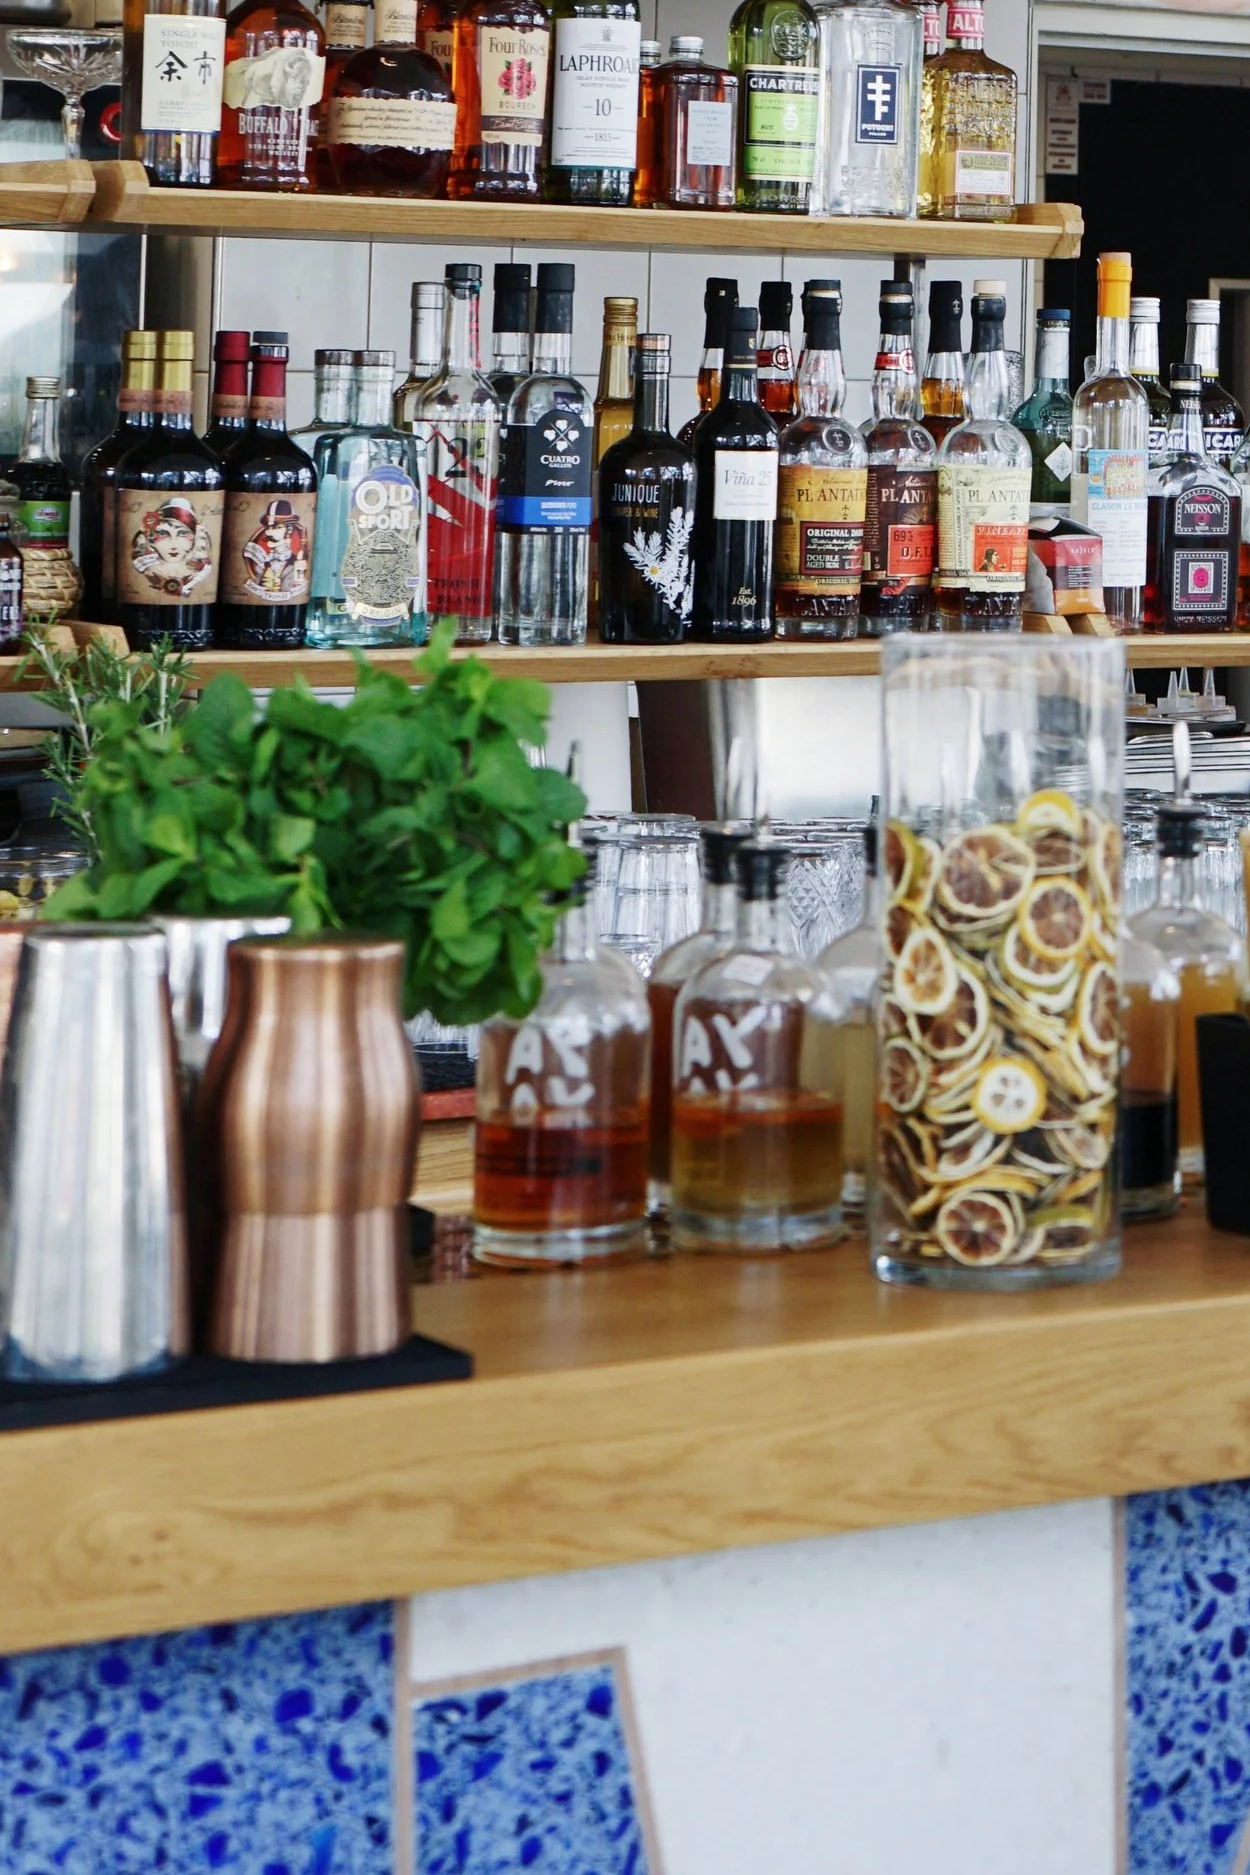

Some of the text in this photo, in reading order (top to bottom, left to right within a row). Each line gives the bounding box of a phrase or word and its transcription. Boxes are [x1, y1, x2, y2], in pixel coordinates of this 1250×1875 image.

[160, 29, 199, 40] SINGLE
[488, 36, 518, 54] Four
[155, 50, 217, 85] 余市
[594, 98, 612, 117] 10
[238, 113, 288, 135] BUFFALO
[594, 132, 613, 142] 1815
[1206, 433, 1244, 449] ICAR
[540, 454, 581, 465] CUATRO
[724, 469, 773, 487] Viña 25
[355, 480, 414, 515] OLD
[611, 483, 660, 504] JUNIQUE
[1091, 502, 1123, 512] CLAIRIN
[1184, 503, 1222, 515] NEISSON
[358, 505, 414, 530] SPORT
[807, 528, 850, 538] ORIGINAL
[893, 530, 907, 543] 69
[806, 554, 840, 562] DOUBLE
[731, 596, 757, 607] 1896
